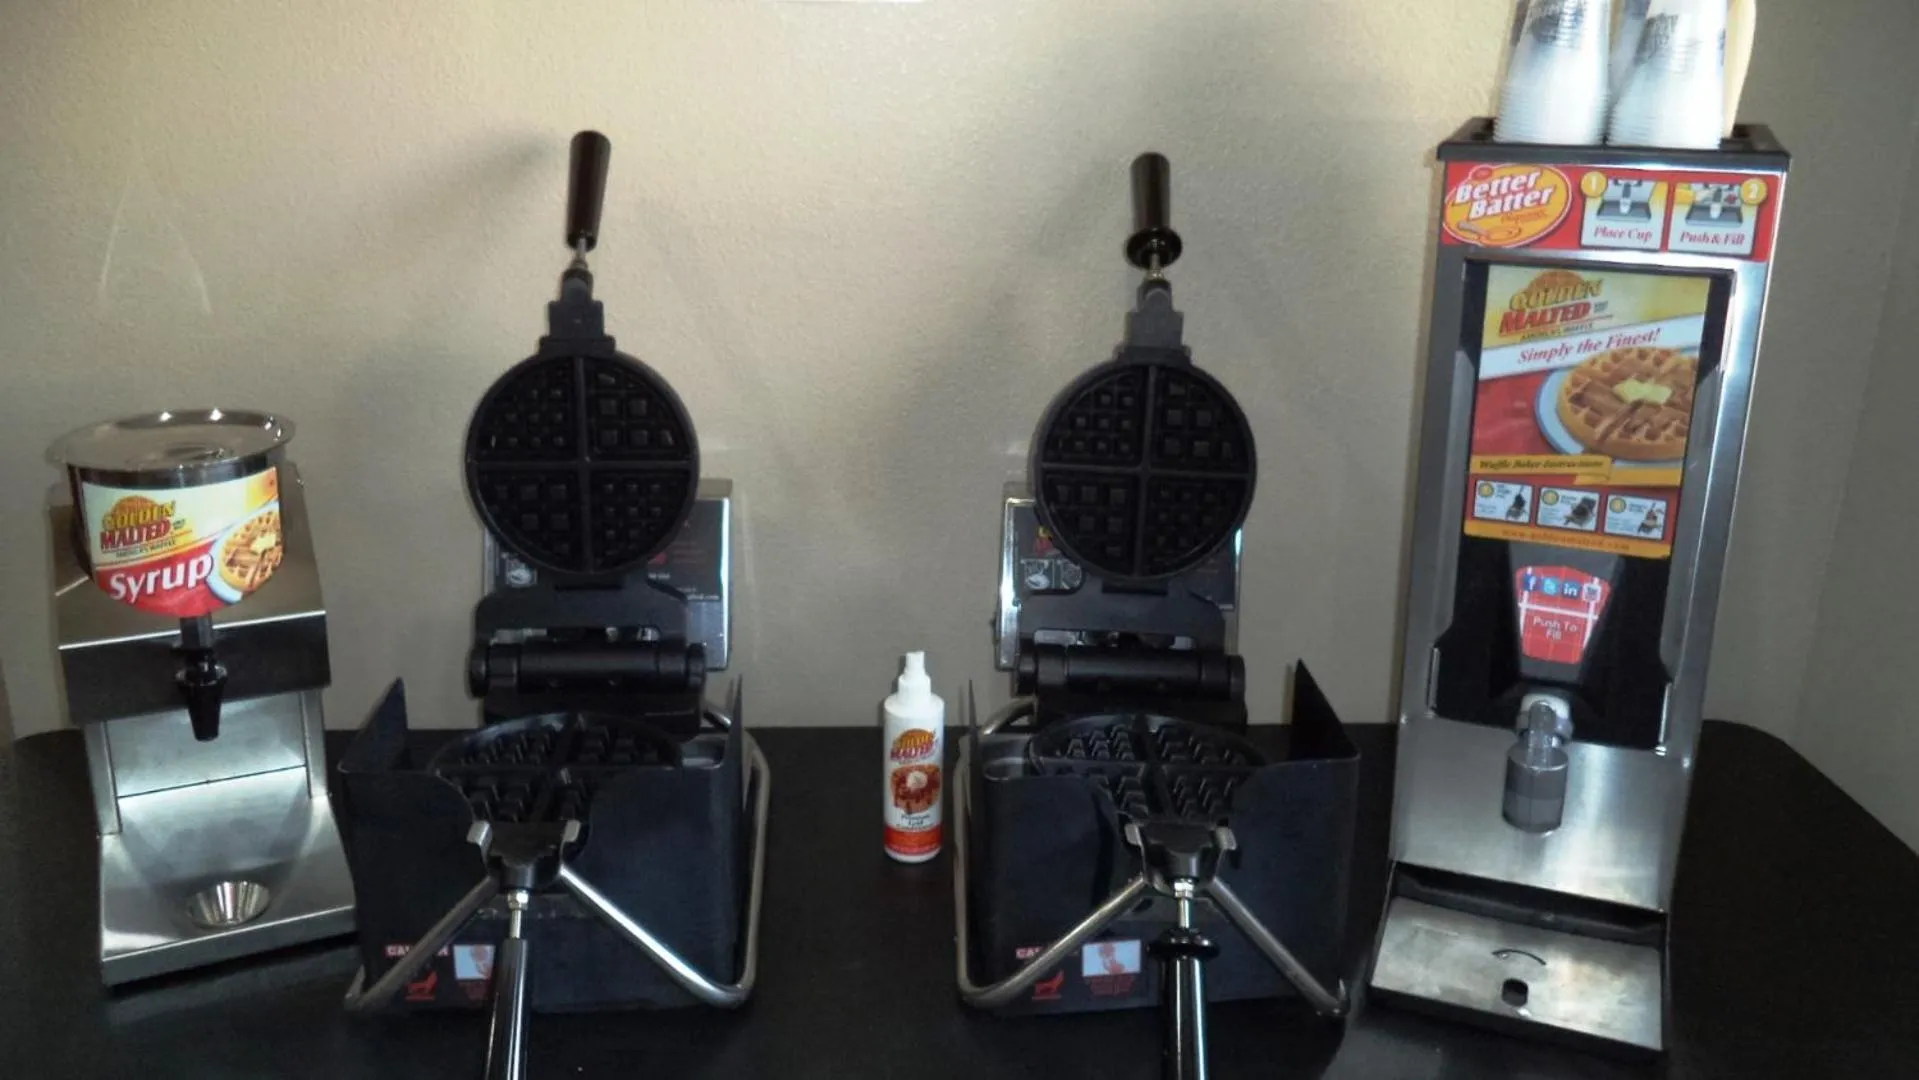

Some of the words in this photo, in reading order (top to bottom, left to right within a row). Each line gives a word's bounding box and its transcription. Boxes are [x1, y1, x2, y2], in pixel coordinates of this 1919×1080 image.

[1453, 168, 1543, 207] Better
[1469, 185, 1556, 222] Batter
[1593, 225, 1626, 240] Place
[1628, 227, 1654, 243] Cup
[1723, 231, 1745, 246] Fill
[1499, 301, 1592, 337] MALTED
[1518, 342, 1572, 365] Simply
[1576, 337, 1603, 353] the
[1606, 327, 1662, 350] Finest!
[102, 500, 176, 531] GOLDEN
[100, 518, 172, 553] MALTED
[108, 553, 214, 604] Syrup
[1533, 615, 1561, 630] Push
[1564, 621, 1578, 632] To
[1546, 629, 1562, 641] Fill
